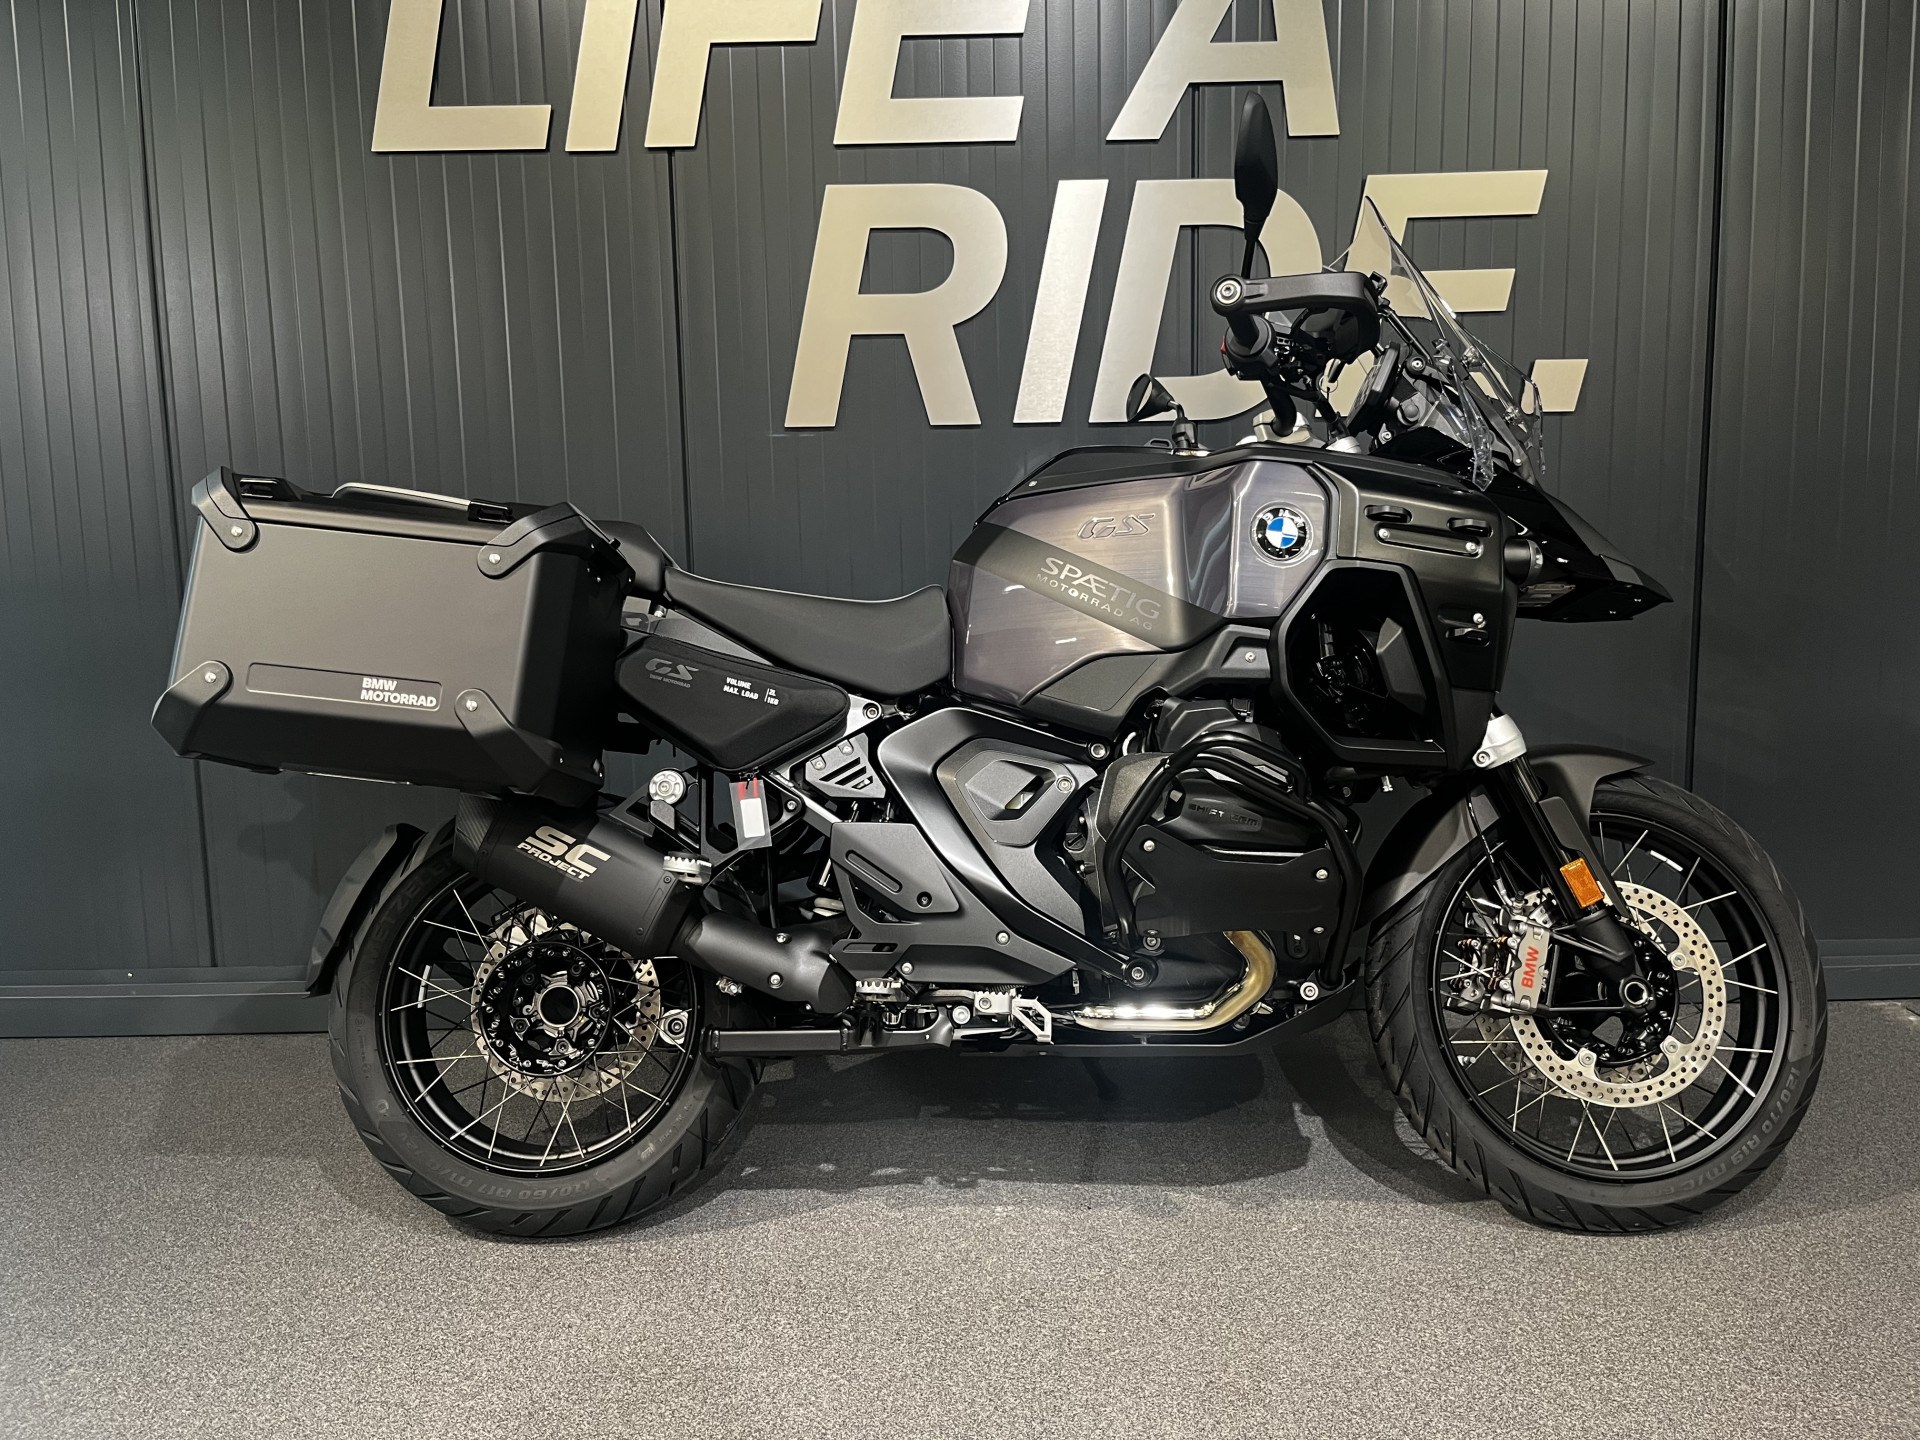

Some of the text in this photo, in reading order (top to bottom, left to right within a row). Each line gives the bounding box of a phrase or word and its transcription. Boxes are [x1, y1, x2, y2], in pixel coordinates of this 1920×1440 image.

[784, 170, 1588, 428] RIDE
[1077, 513, 1156, 540] GS
[1036, 573, 1153, 631] MOTORRAD AG
[645, 657, 699, 681] GS
[663, 677, 691, 688] MOTORRAD
[362, 677, 398, 691] BMW
[723, 685, 740, 695] MAX.
[741, 689, 759, 700] LOAD
[726, 676, 752, 690] VOLUME
[360, 689, 437, 708] MOTORRAD
[1188, 803, 1225, 818] SHIFT
[516, 841, 591, 880] PROJECT
[525, 825, 612, 875] SC
[1521, 945, 1540, 989] BMW
[1761, 1066, 1801, 1135] 120/70
[1732, 1134, 1762, 1166] R19
